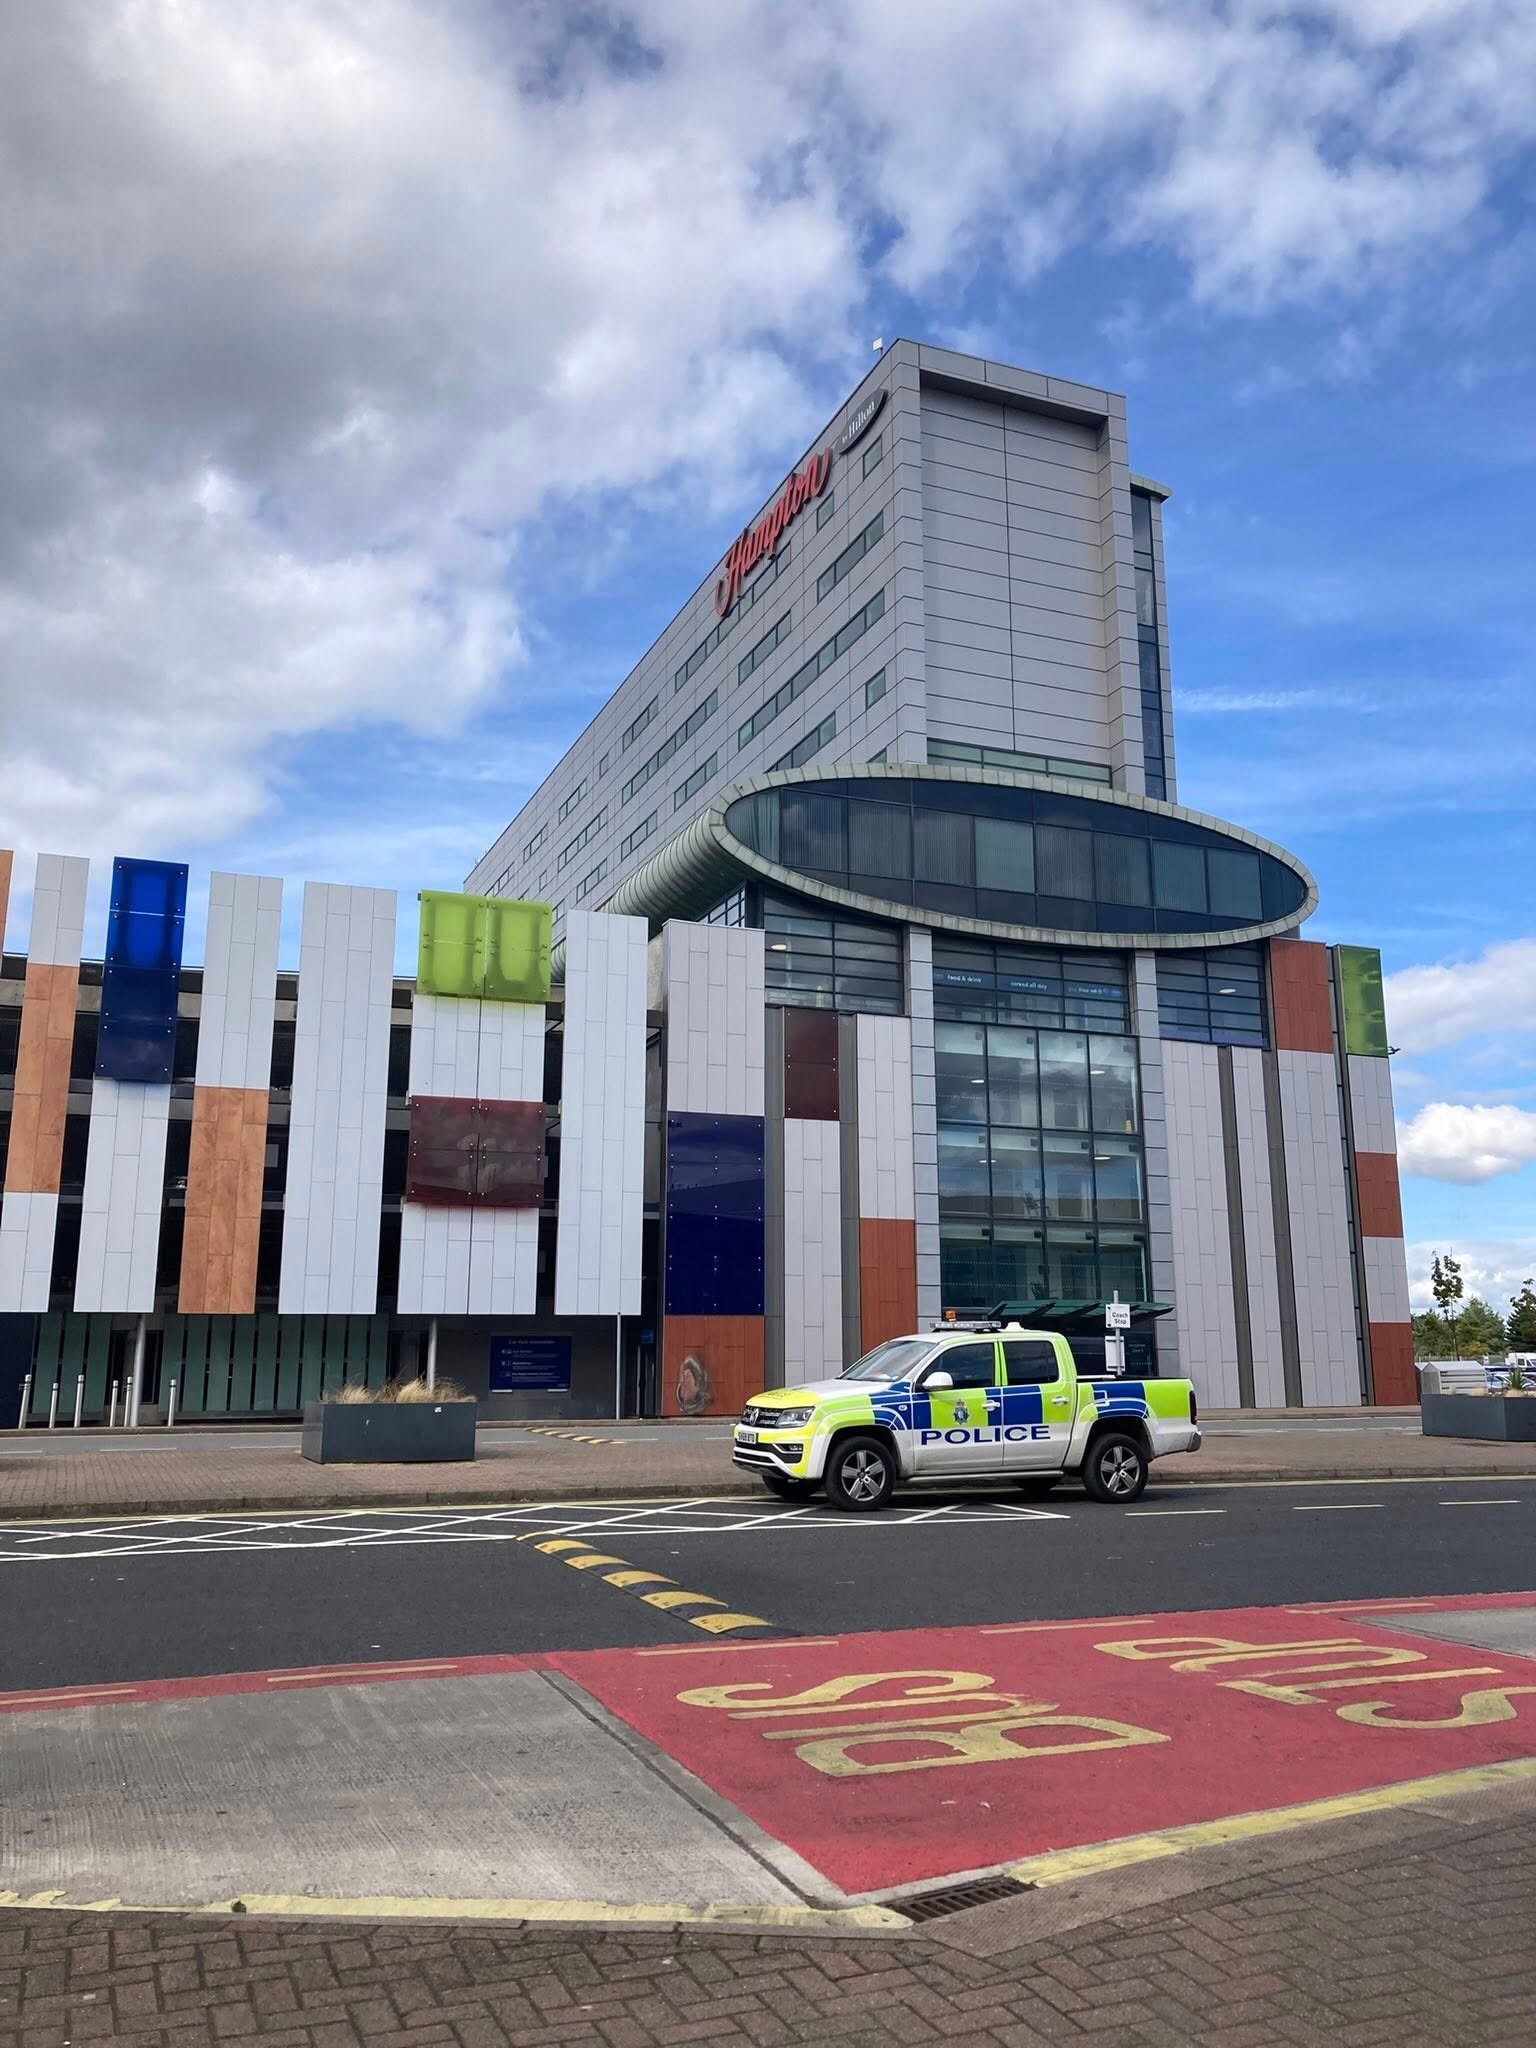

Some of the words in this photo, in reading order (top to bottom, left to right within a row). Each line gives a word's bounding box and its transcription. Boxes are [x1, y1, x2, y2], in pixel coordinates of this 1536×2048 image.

[715, 448, 832, 617] Hampton
[849, 401, 875, 439] Hilton
[921, 1425, 1050, 1445] POLICE
[677, 1670, 1172, 1777] BUS
[1093, 1637, 1536, 1728] STOP
